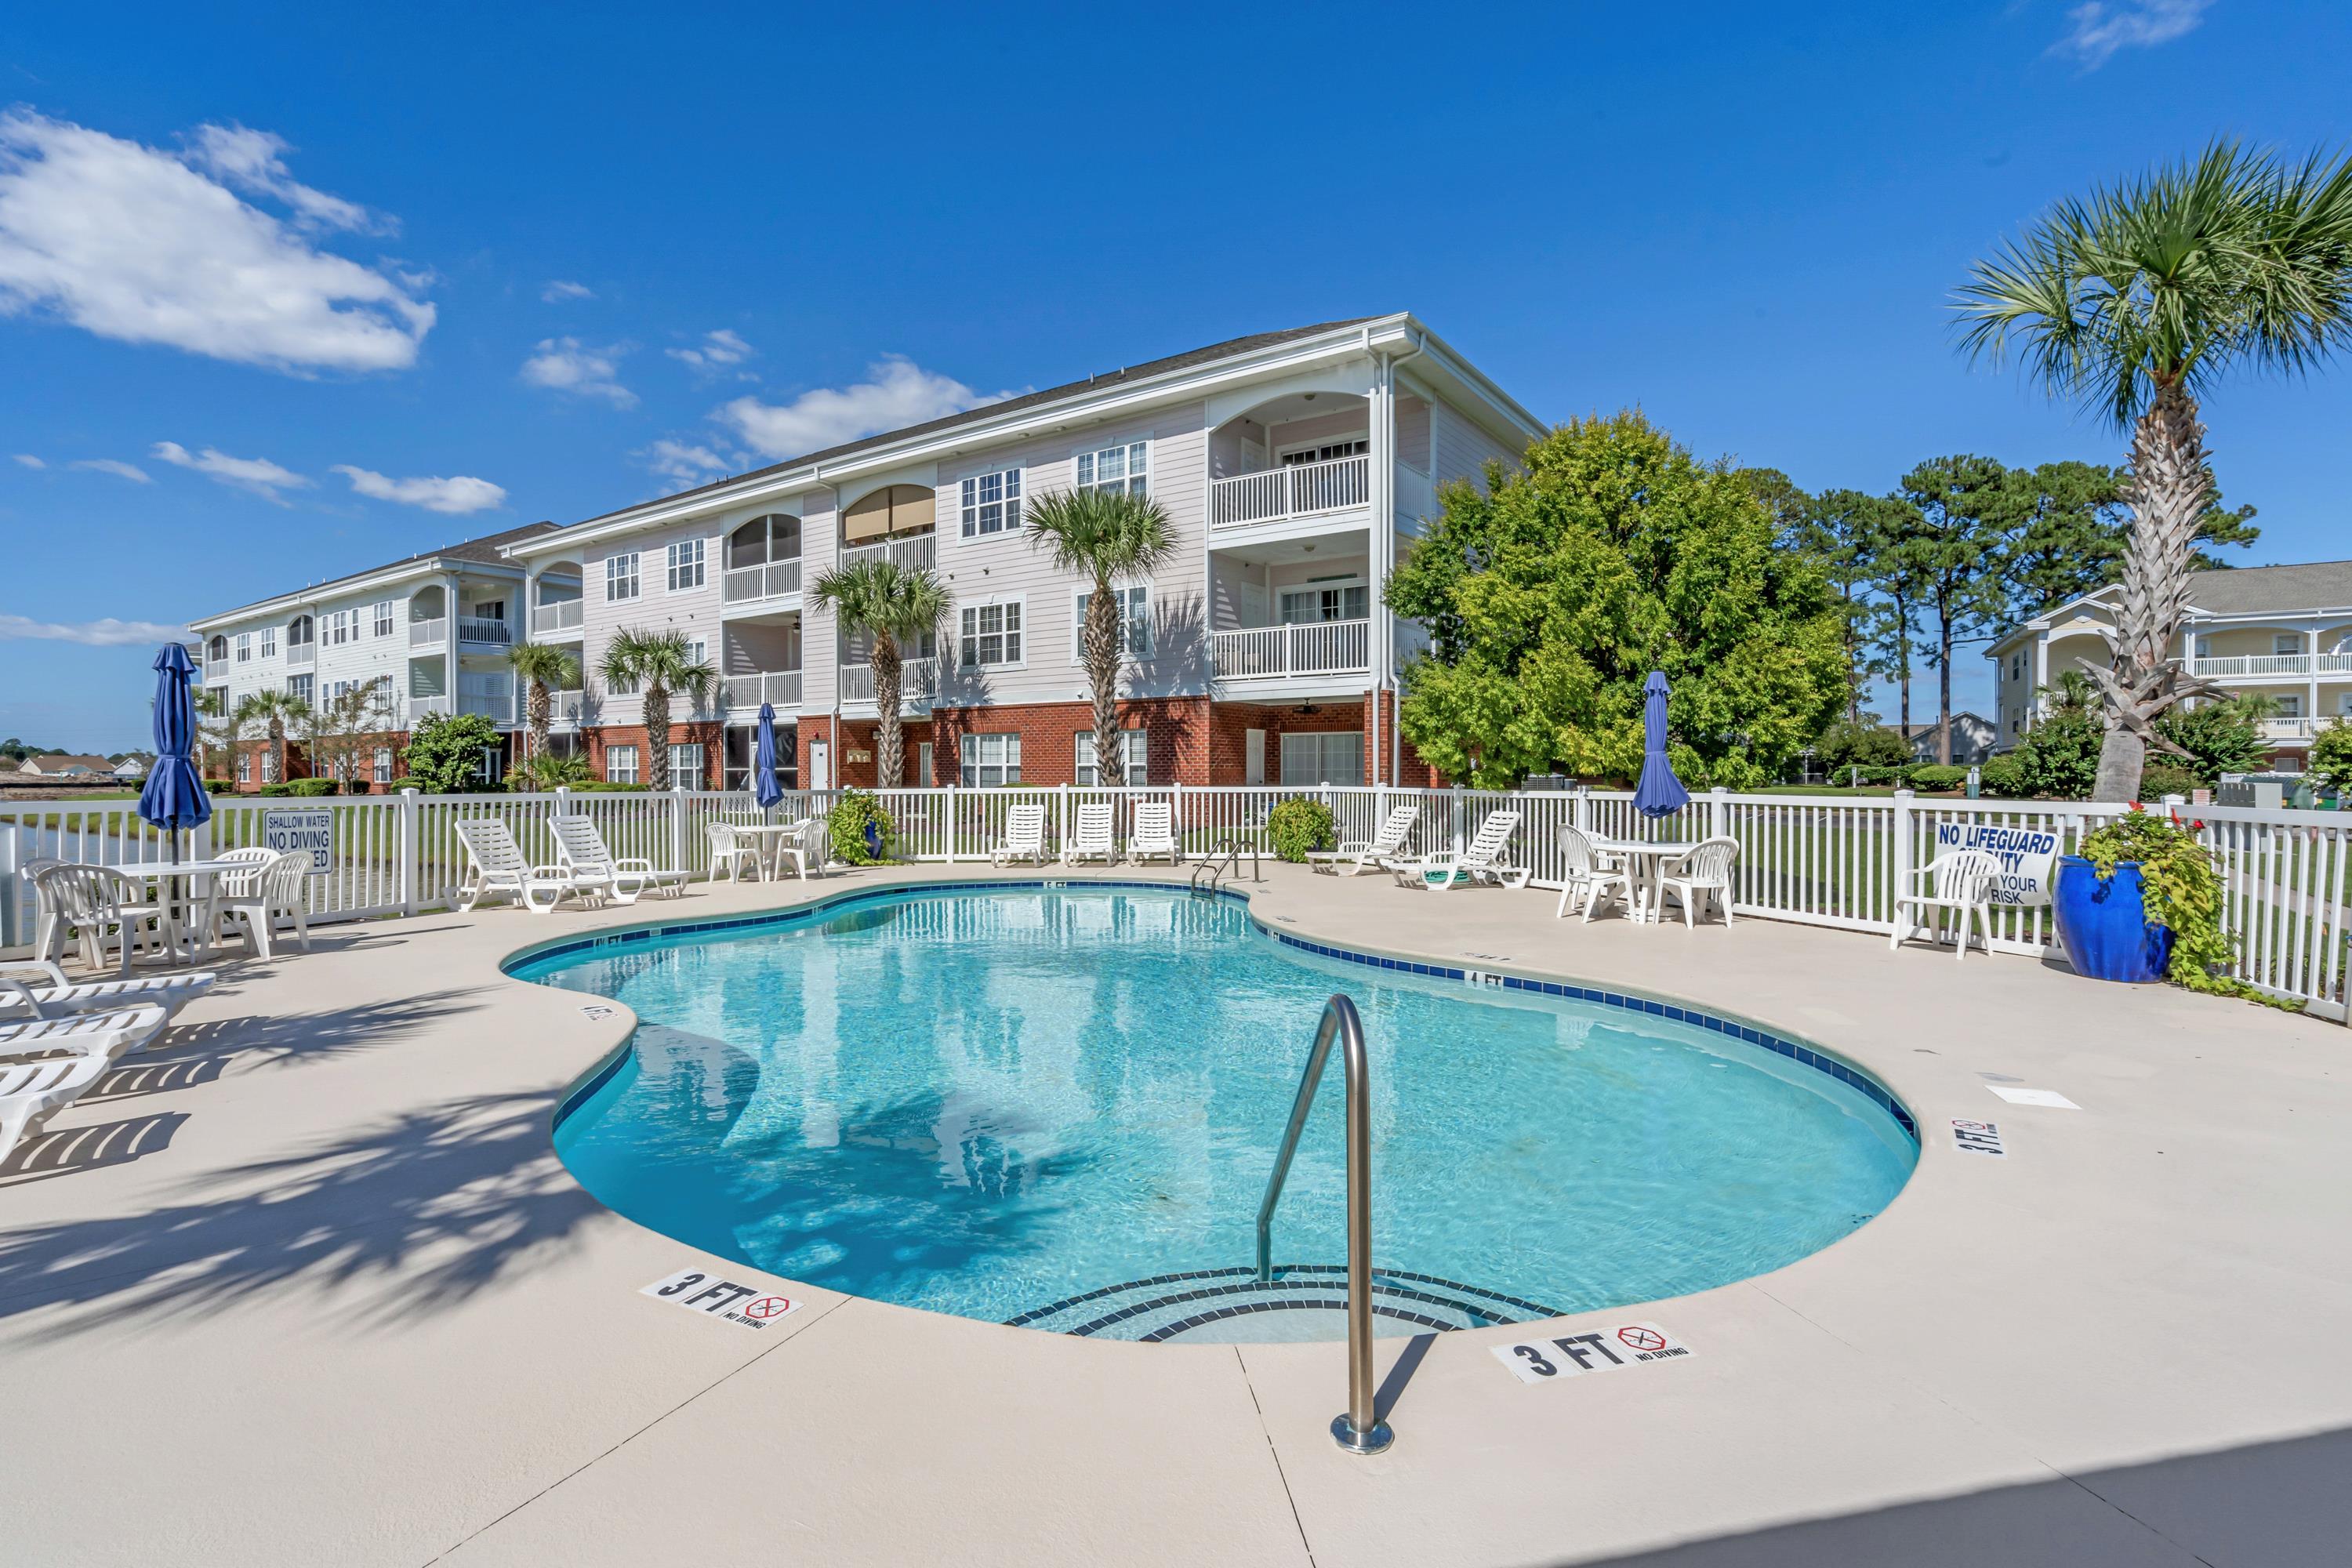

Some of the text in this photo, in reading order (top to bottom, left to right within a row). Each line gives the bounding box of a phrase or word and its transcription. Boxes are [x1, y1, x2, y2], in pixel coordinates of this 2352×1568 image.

[269, 815, 329, 829] SHALLOW WATER
[269, 830, 328, 849] NO DIVING
[1939, 825, 2055, 855] NO LIFEGUARD
[2001, 875, 2038, 892] YOUR
[1991, 889, 2024, 904] RISK
[1955, 1129, 2004, 1154] 3 FT
[658, 1274, 758, 1312] 3 FT
[723, 1311, 766, 1329] NO DIVING
[1513, 1334, 1624, 1376] 3 FT
[1636, 1347, 1689, 1361] NO DIVING
